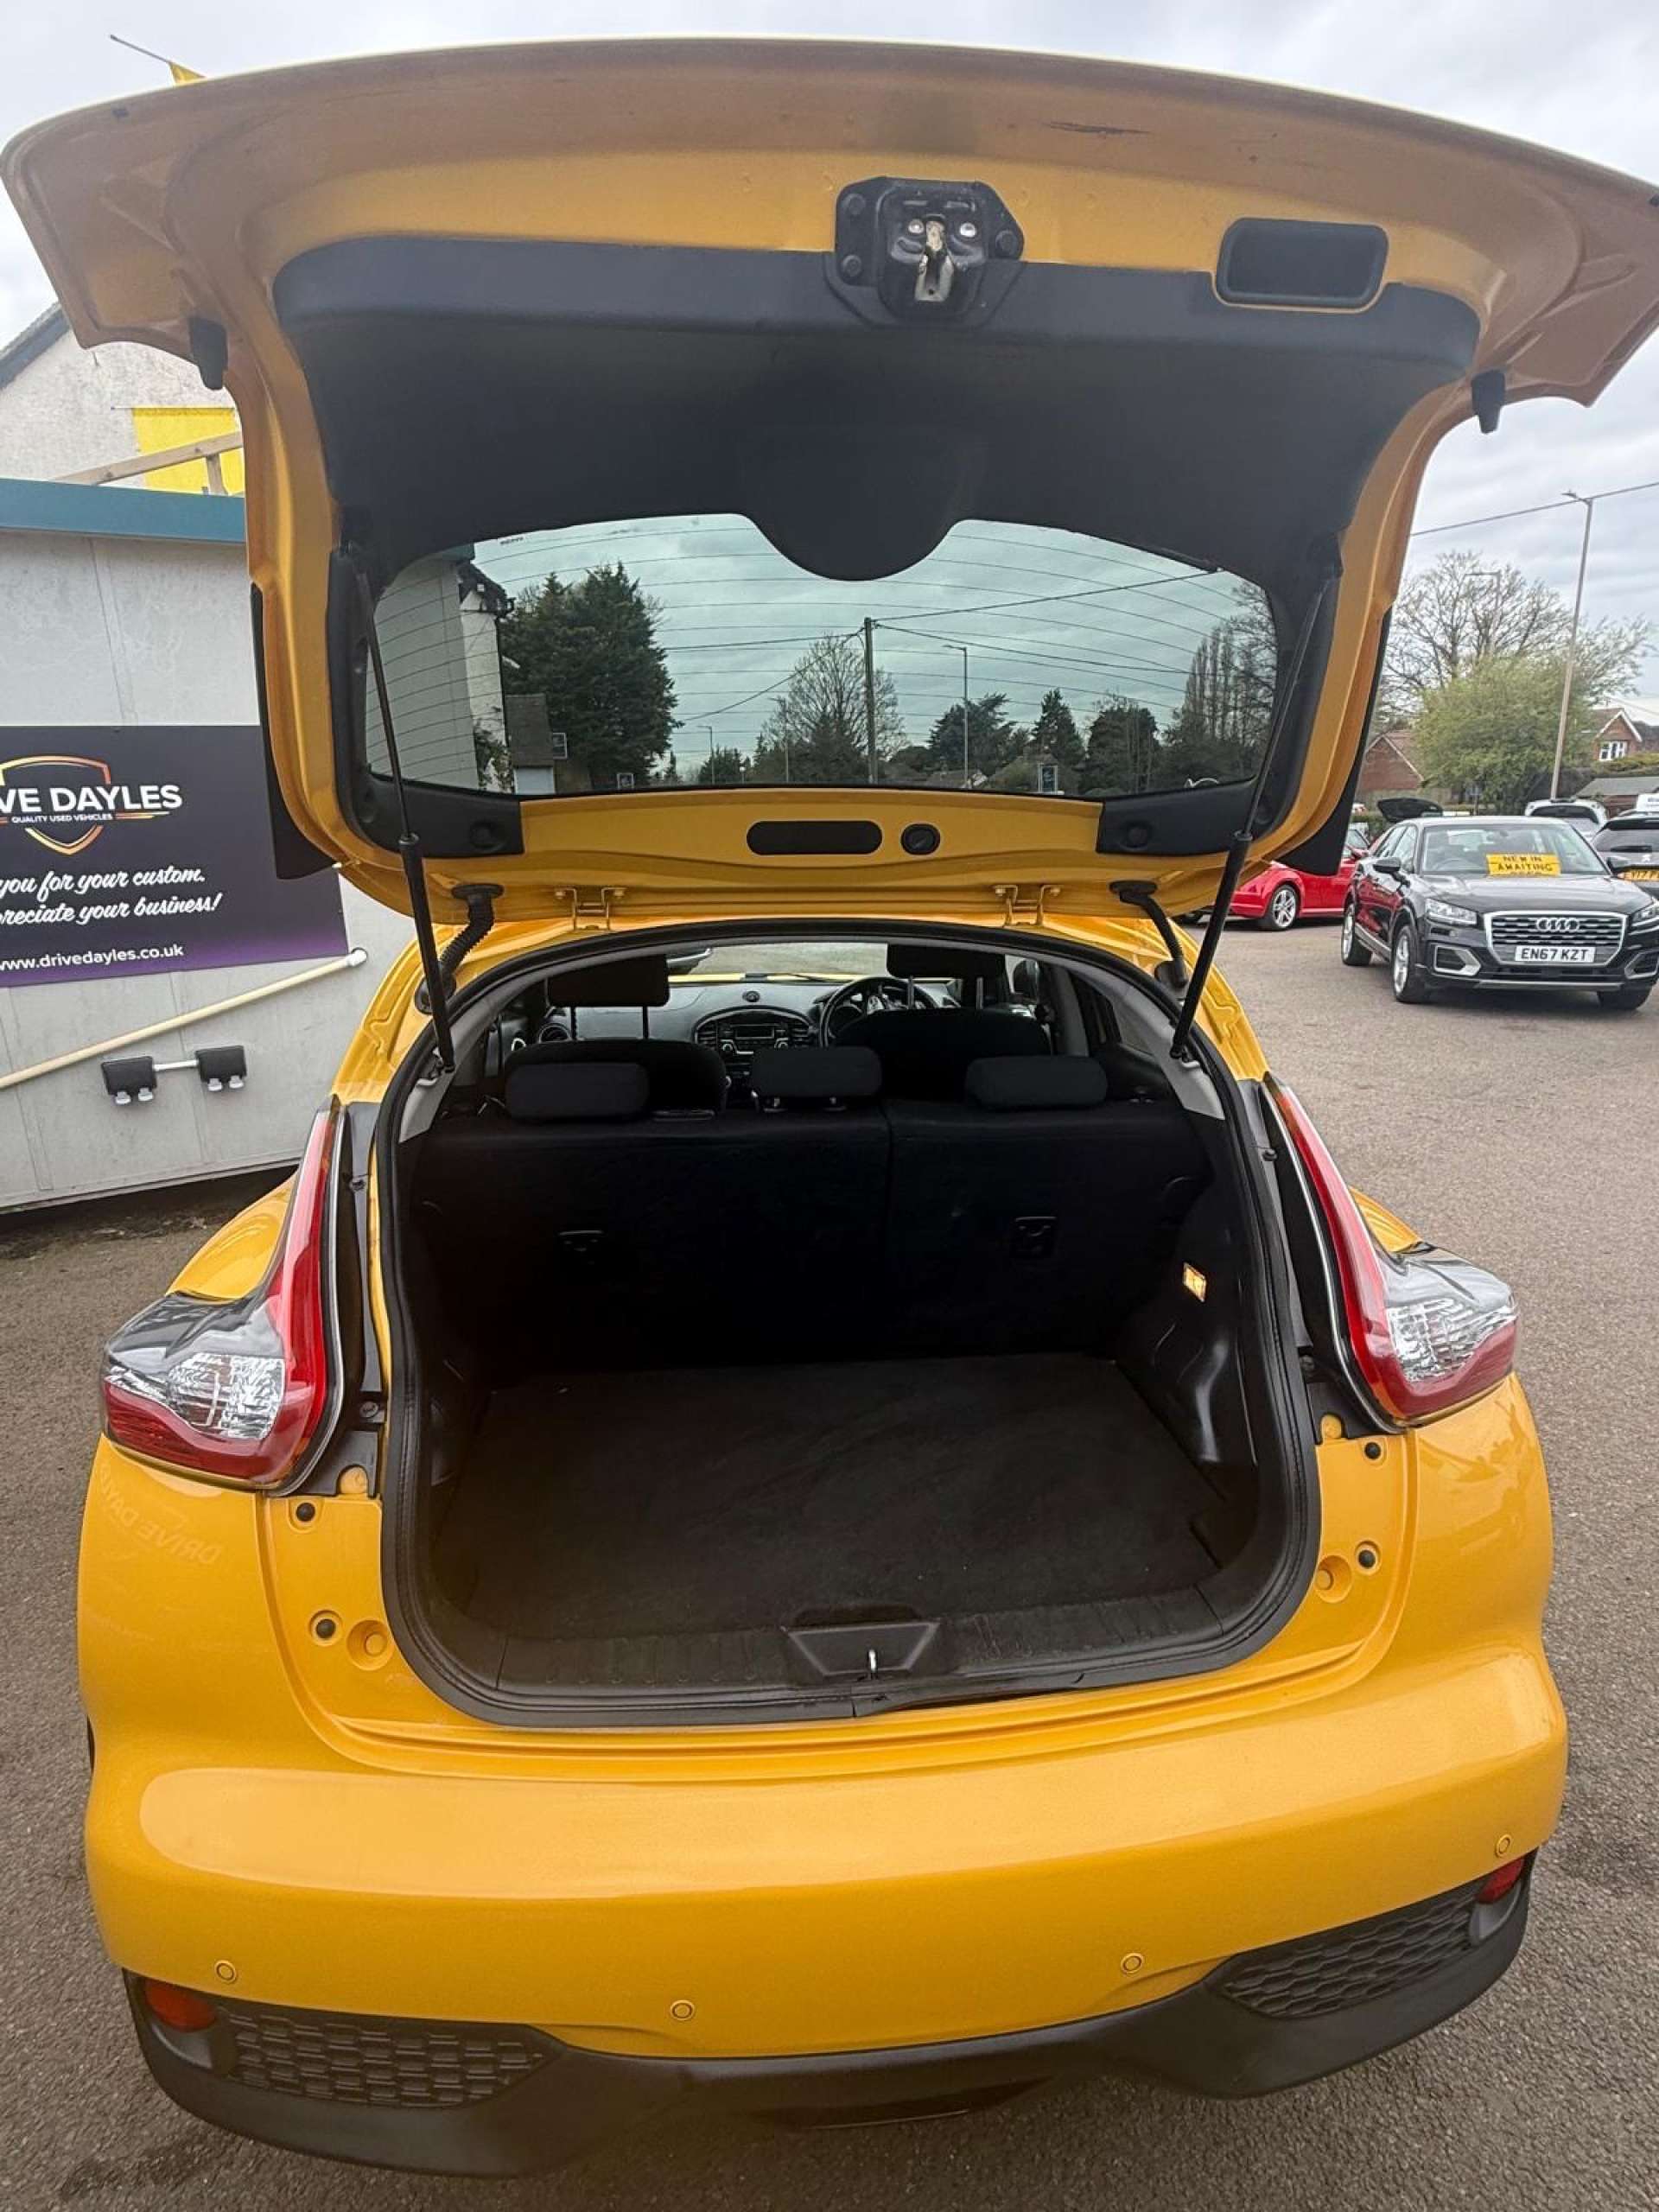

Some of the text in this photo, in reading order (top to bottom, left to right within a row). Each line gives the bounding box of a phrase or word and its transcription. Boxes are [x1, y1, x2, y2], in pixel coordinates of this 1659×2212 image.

[49, 784, 183, 812] DAYLES
[11, 815, 48, 823] QUALITY
[1498, 863, 1554, 872] AWAITING
[37, 871, 74, 902] for
[74, 872, 129, 894] your
[132, 865, 206, 887] custom.
[76, 902, 130, 925] your
[134, 893, 223, 916] business!
[1522, 948, 1588, 961] EN67 KZT
